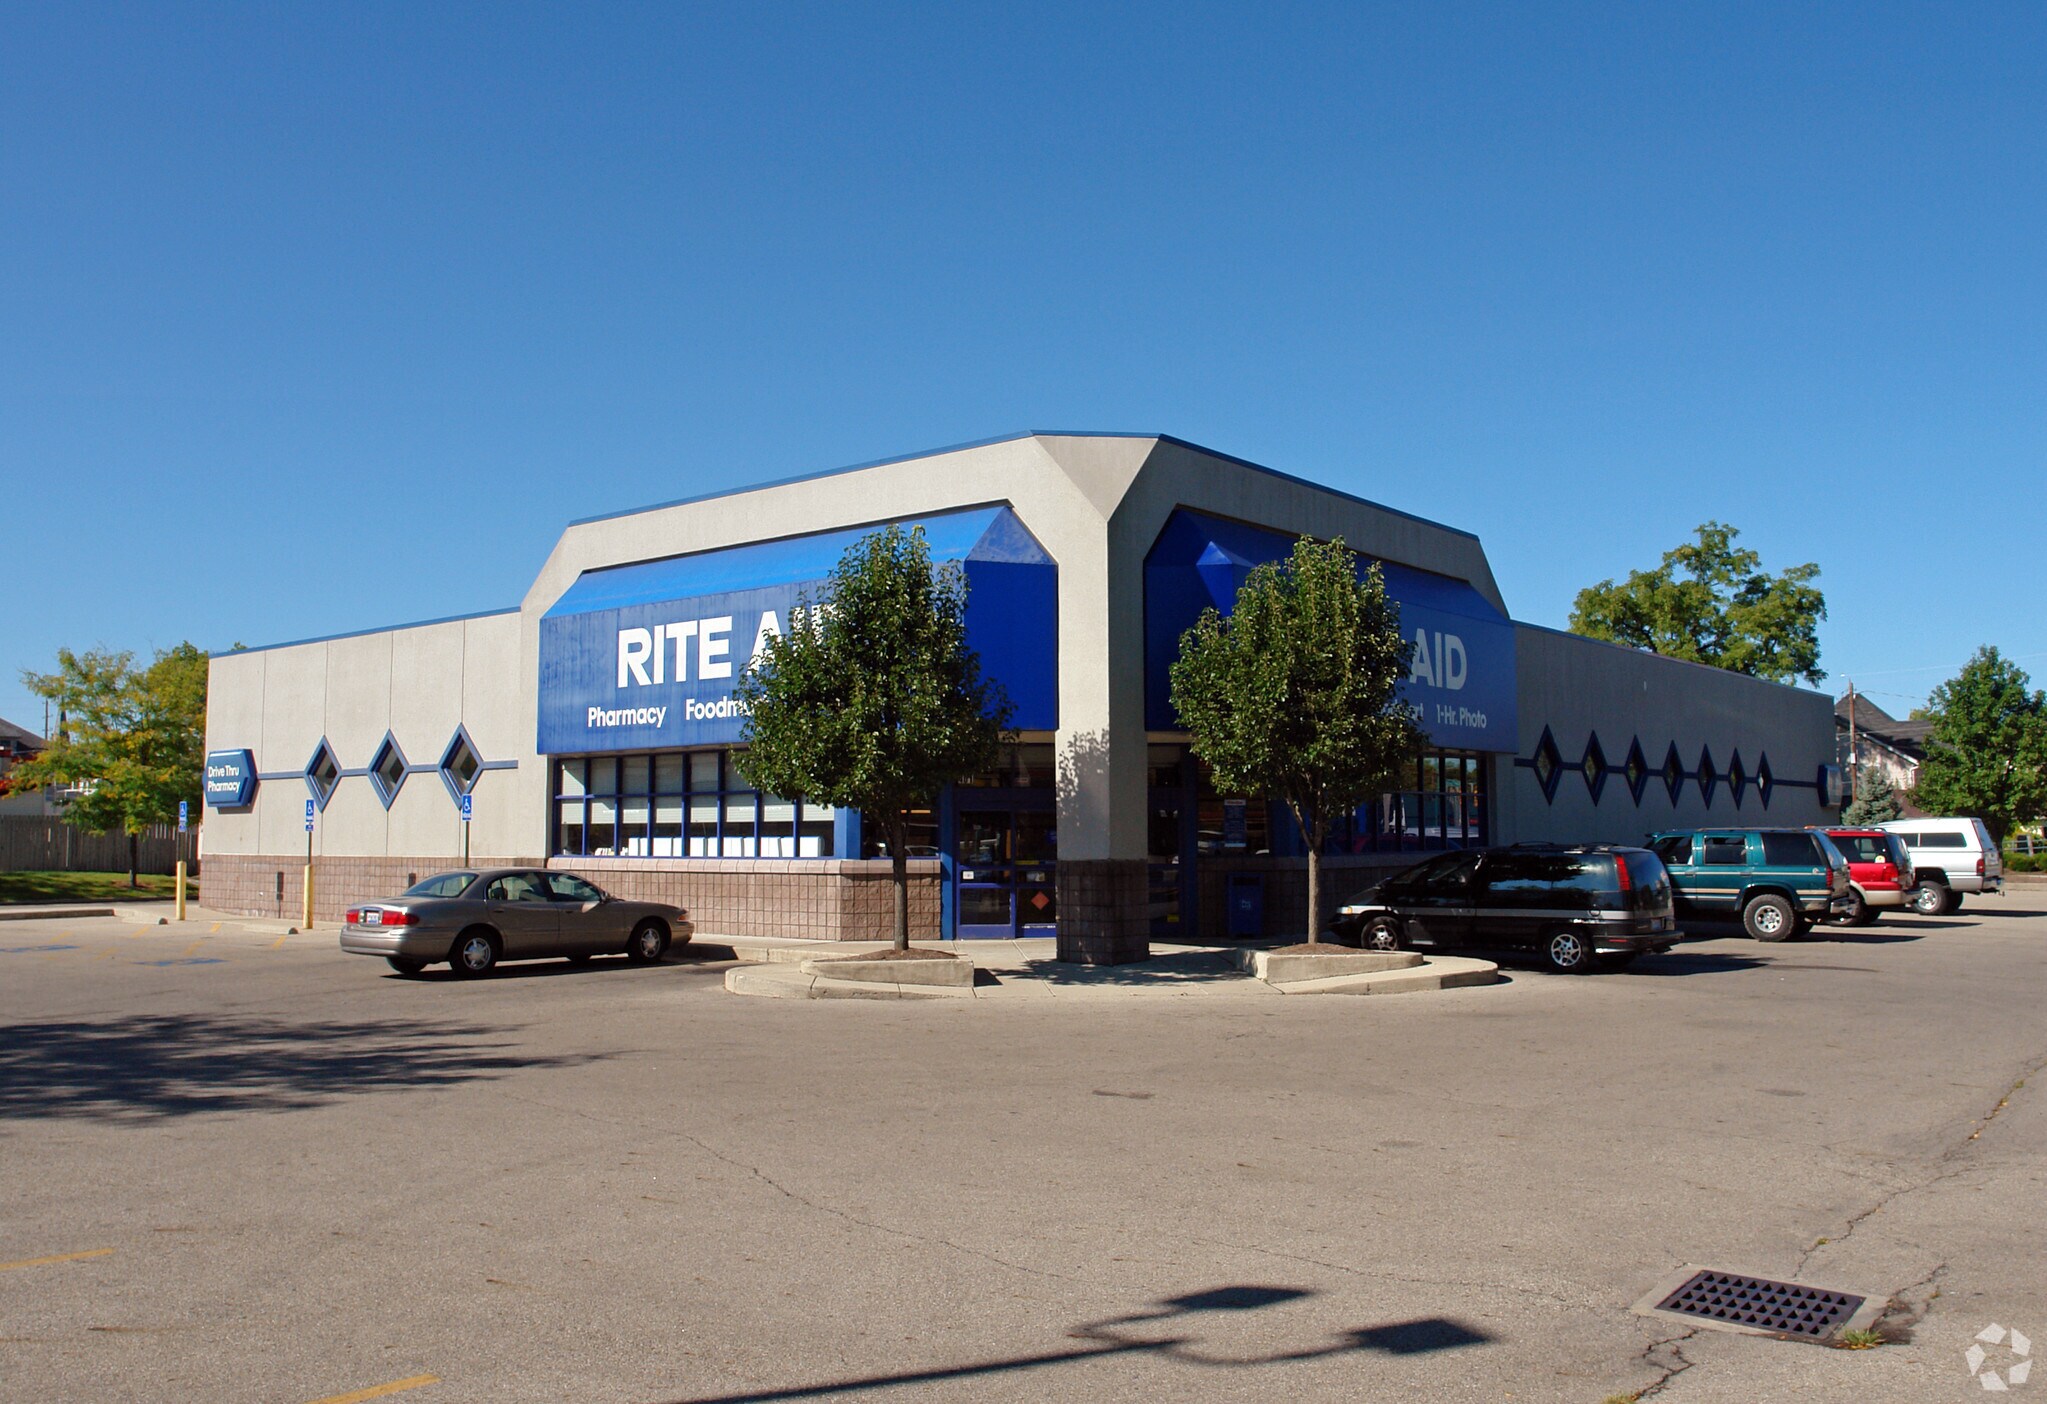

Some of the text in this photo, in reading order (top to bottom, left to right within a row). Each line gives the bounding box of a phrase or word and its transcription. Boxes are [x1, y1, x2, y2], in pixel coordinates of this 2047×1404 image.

[617, 615, 732, 688] RITE
[1409, 628, 1467, 690] AID
[588, 706, 667, 728] Pharmacy
[1436, 704, 1458, 726] 1-Hr.
[1459, 707, 1487, 729] Photo
[208, 765, 239, 778] Drive Thru
[208, 780, 240, 793] Pharmacy
